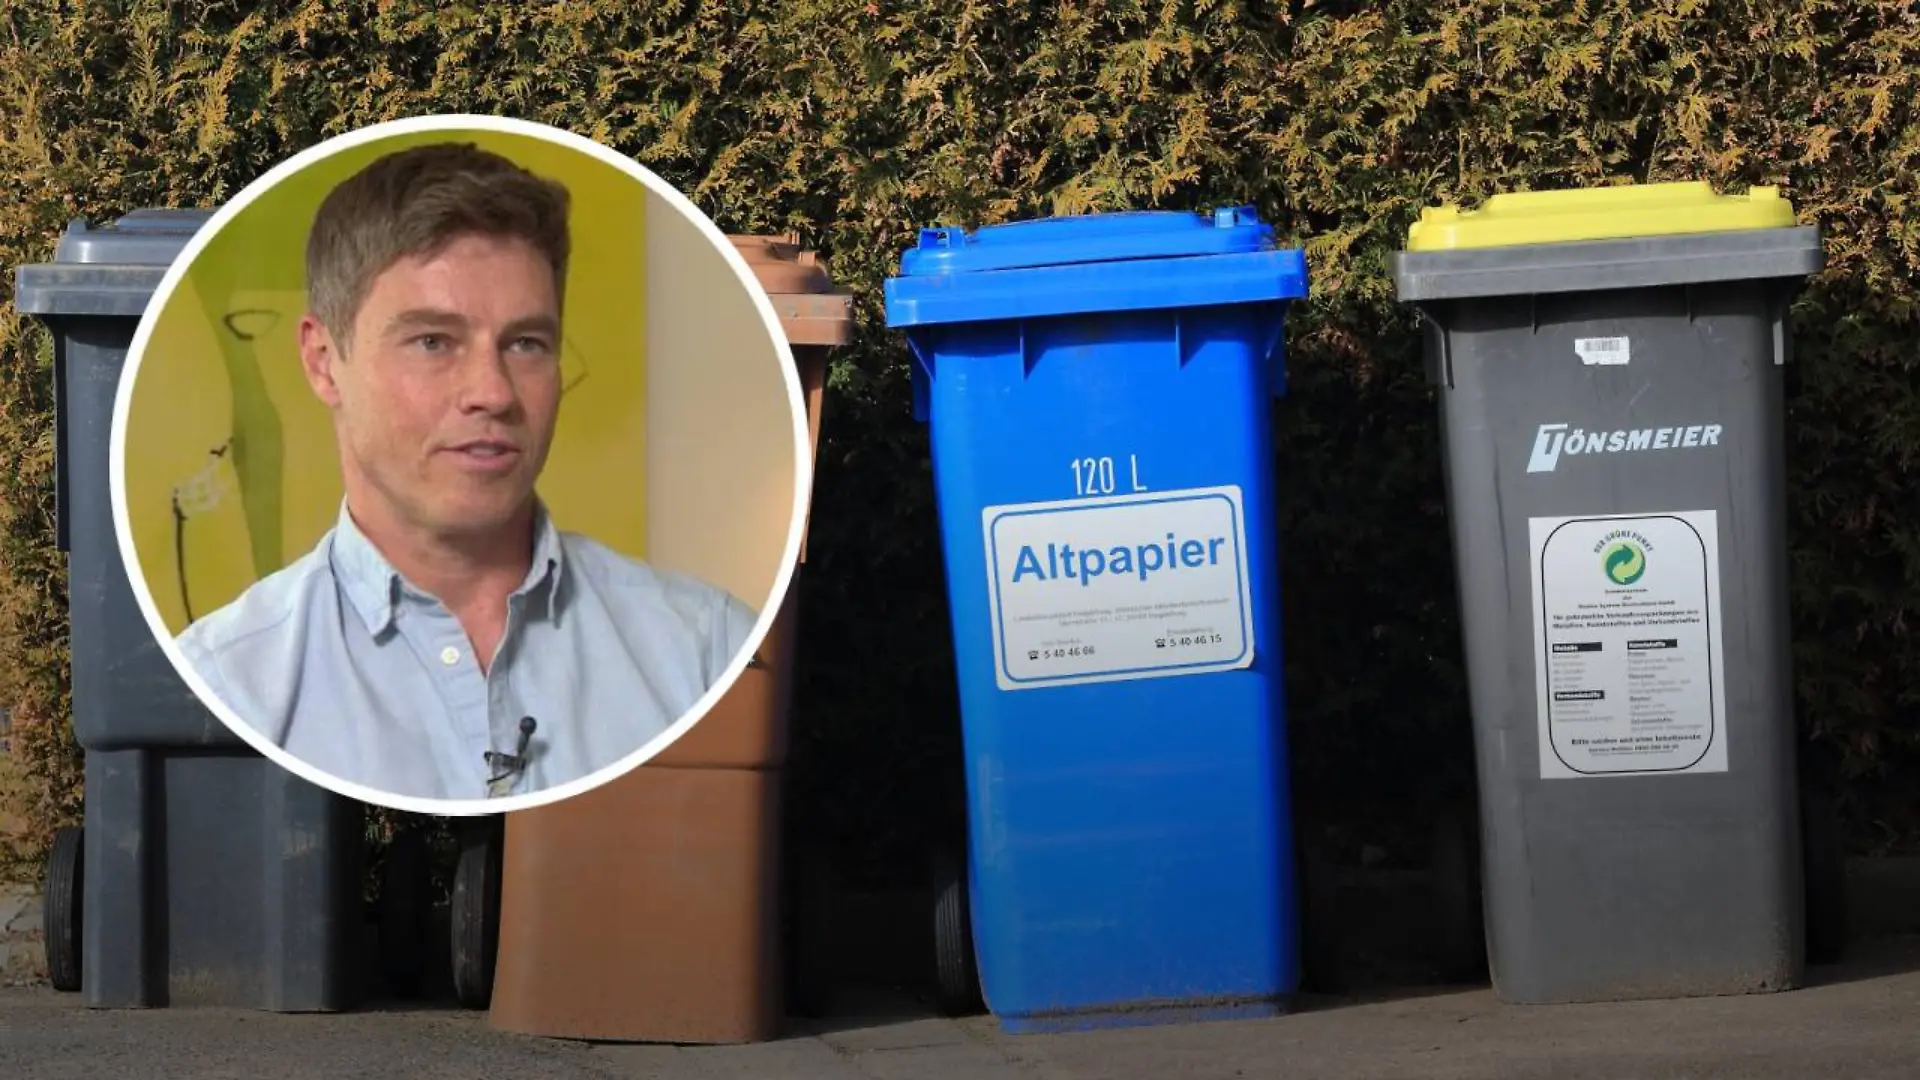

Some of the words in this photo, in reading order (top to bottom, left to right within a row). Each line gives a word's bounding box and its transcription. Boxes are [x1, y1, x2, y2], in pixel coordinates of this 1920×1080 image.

[1526, 423, 1722, 474] TÖNSMEIER
[1071, 456, 1115, 496] 120
[1131, 453, 1148, 492] L
[1012, 532, 1225, 587] Altpapier
